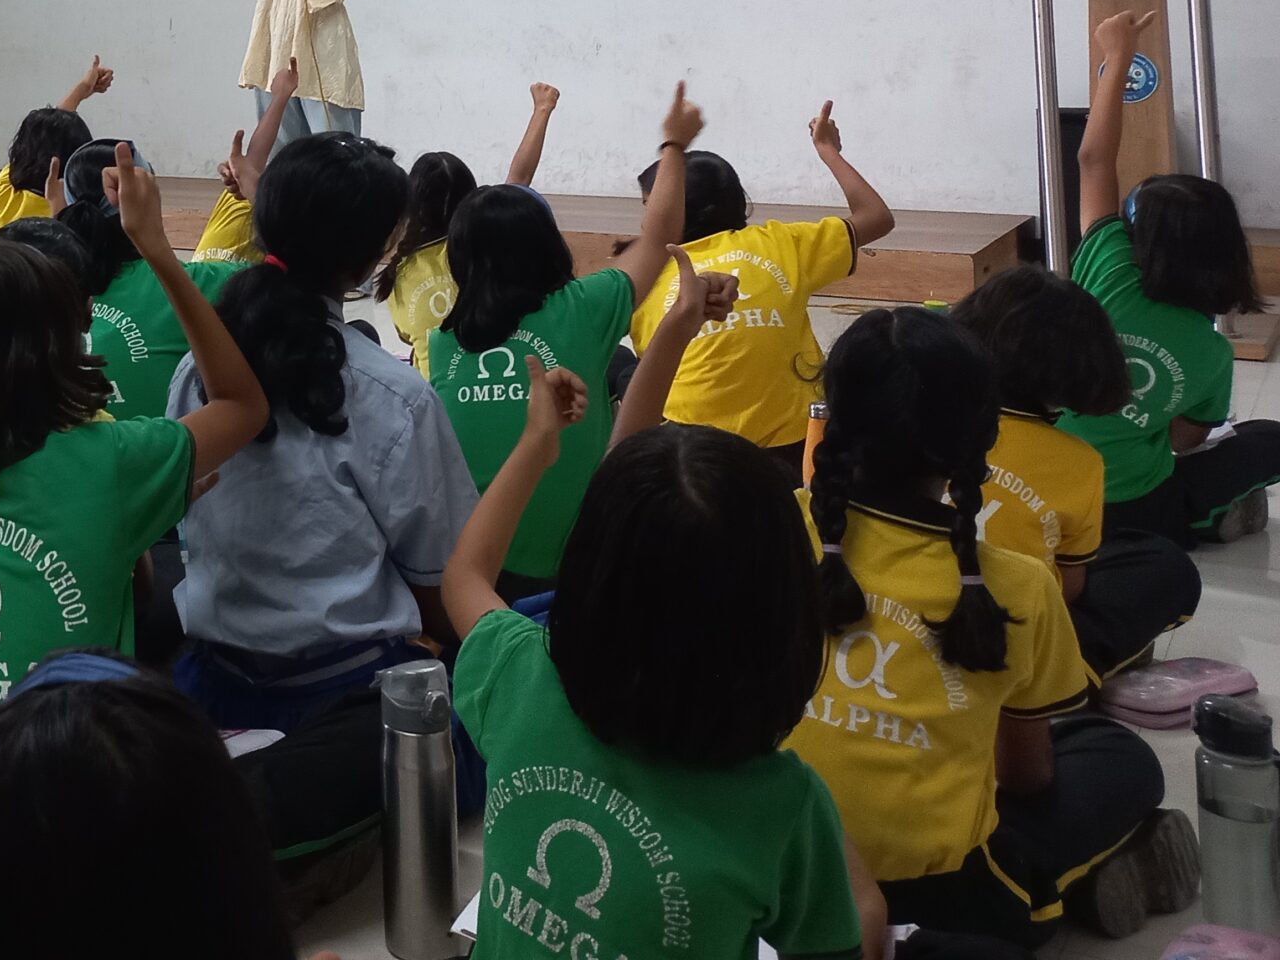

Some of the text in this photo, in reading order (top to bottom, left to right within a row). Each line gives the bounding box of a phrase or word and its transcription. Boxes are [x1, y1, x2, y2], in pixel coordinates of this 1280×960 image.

[718, 250, 762, 266] WISDOM
[761, 260, 793, 296] SCHOOL
[91, 303, 124, 324] ISDOM
[116, 317, 149, 363] SCHOOL
[447, 353, 462, 380] SUYOG
[458, 383, 531, 402] OMEG
[36, 550, 89, 632] SCHOOL
[932, 652, 968, 711] HOOL
[804, 695, 932, 749] ALPHA
[511, 766, 606, 805] SUNDERJI
[604, 788, 674, 868] WISDOM
[489, 872, 630, 960] OMEG
